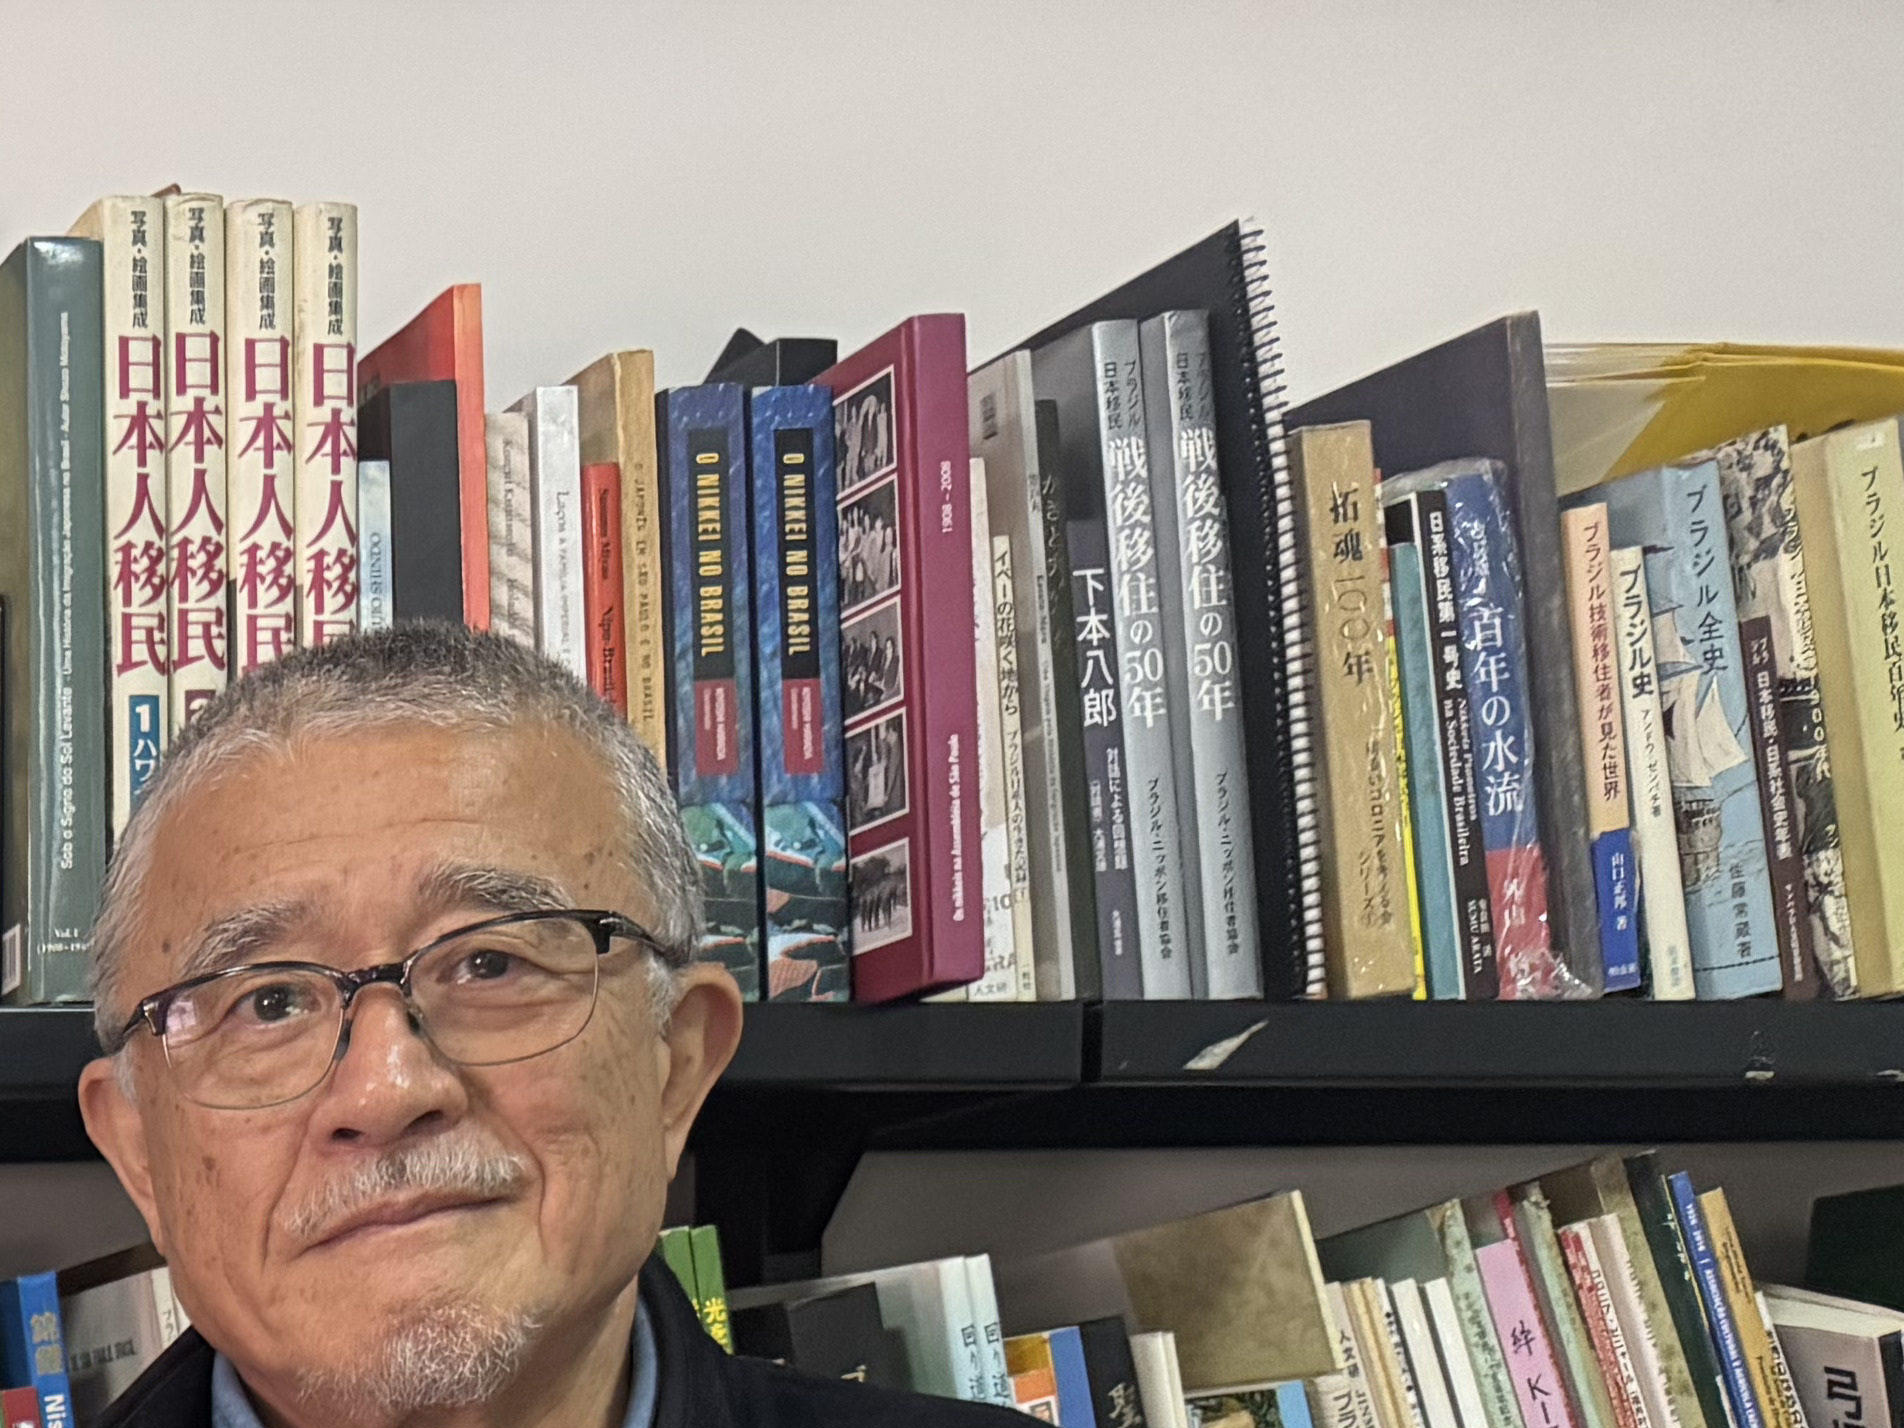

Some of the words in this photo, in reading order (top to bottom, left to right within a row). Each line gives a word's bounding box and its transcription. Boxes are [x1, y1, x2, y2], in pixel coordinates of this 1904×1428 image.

[1123, 359, 1141, 430] ブラジル
[696, 453, 719, 463] O
[783, 453, 805, 463] O
[113, 334, 168, 676] 日本人移民
[169, 331, 227, 672] 日本人移民
[237, 336, 294, 674] 日本人移民
[697, 474, 721, 541] NIKKEI
[784, 474, 807, 541] NIKKEI
[699, 551, 722, 577] NO
[786, 551, 808, 576] NO
[1108, 438, 1165, 728] 戦後移住の50年
[1181, 429, 1234, 721] 戦後移住の50年
[1686, 485, 1729, 674] ブラジル全史
[700, 586, 725, 657] BRASIL
[787, 586, 810, 656] BRASIL
[1072, 568, 1117, 726] 下本八郎
[1619, 566, 1655, 700] ブラジル史
[1582, 521, 1621, 802] ブラジル技術移住者が見た世界
[1510, 1319, 1534, 1358] 絆
